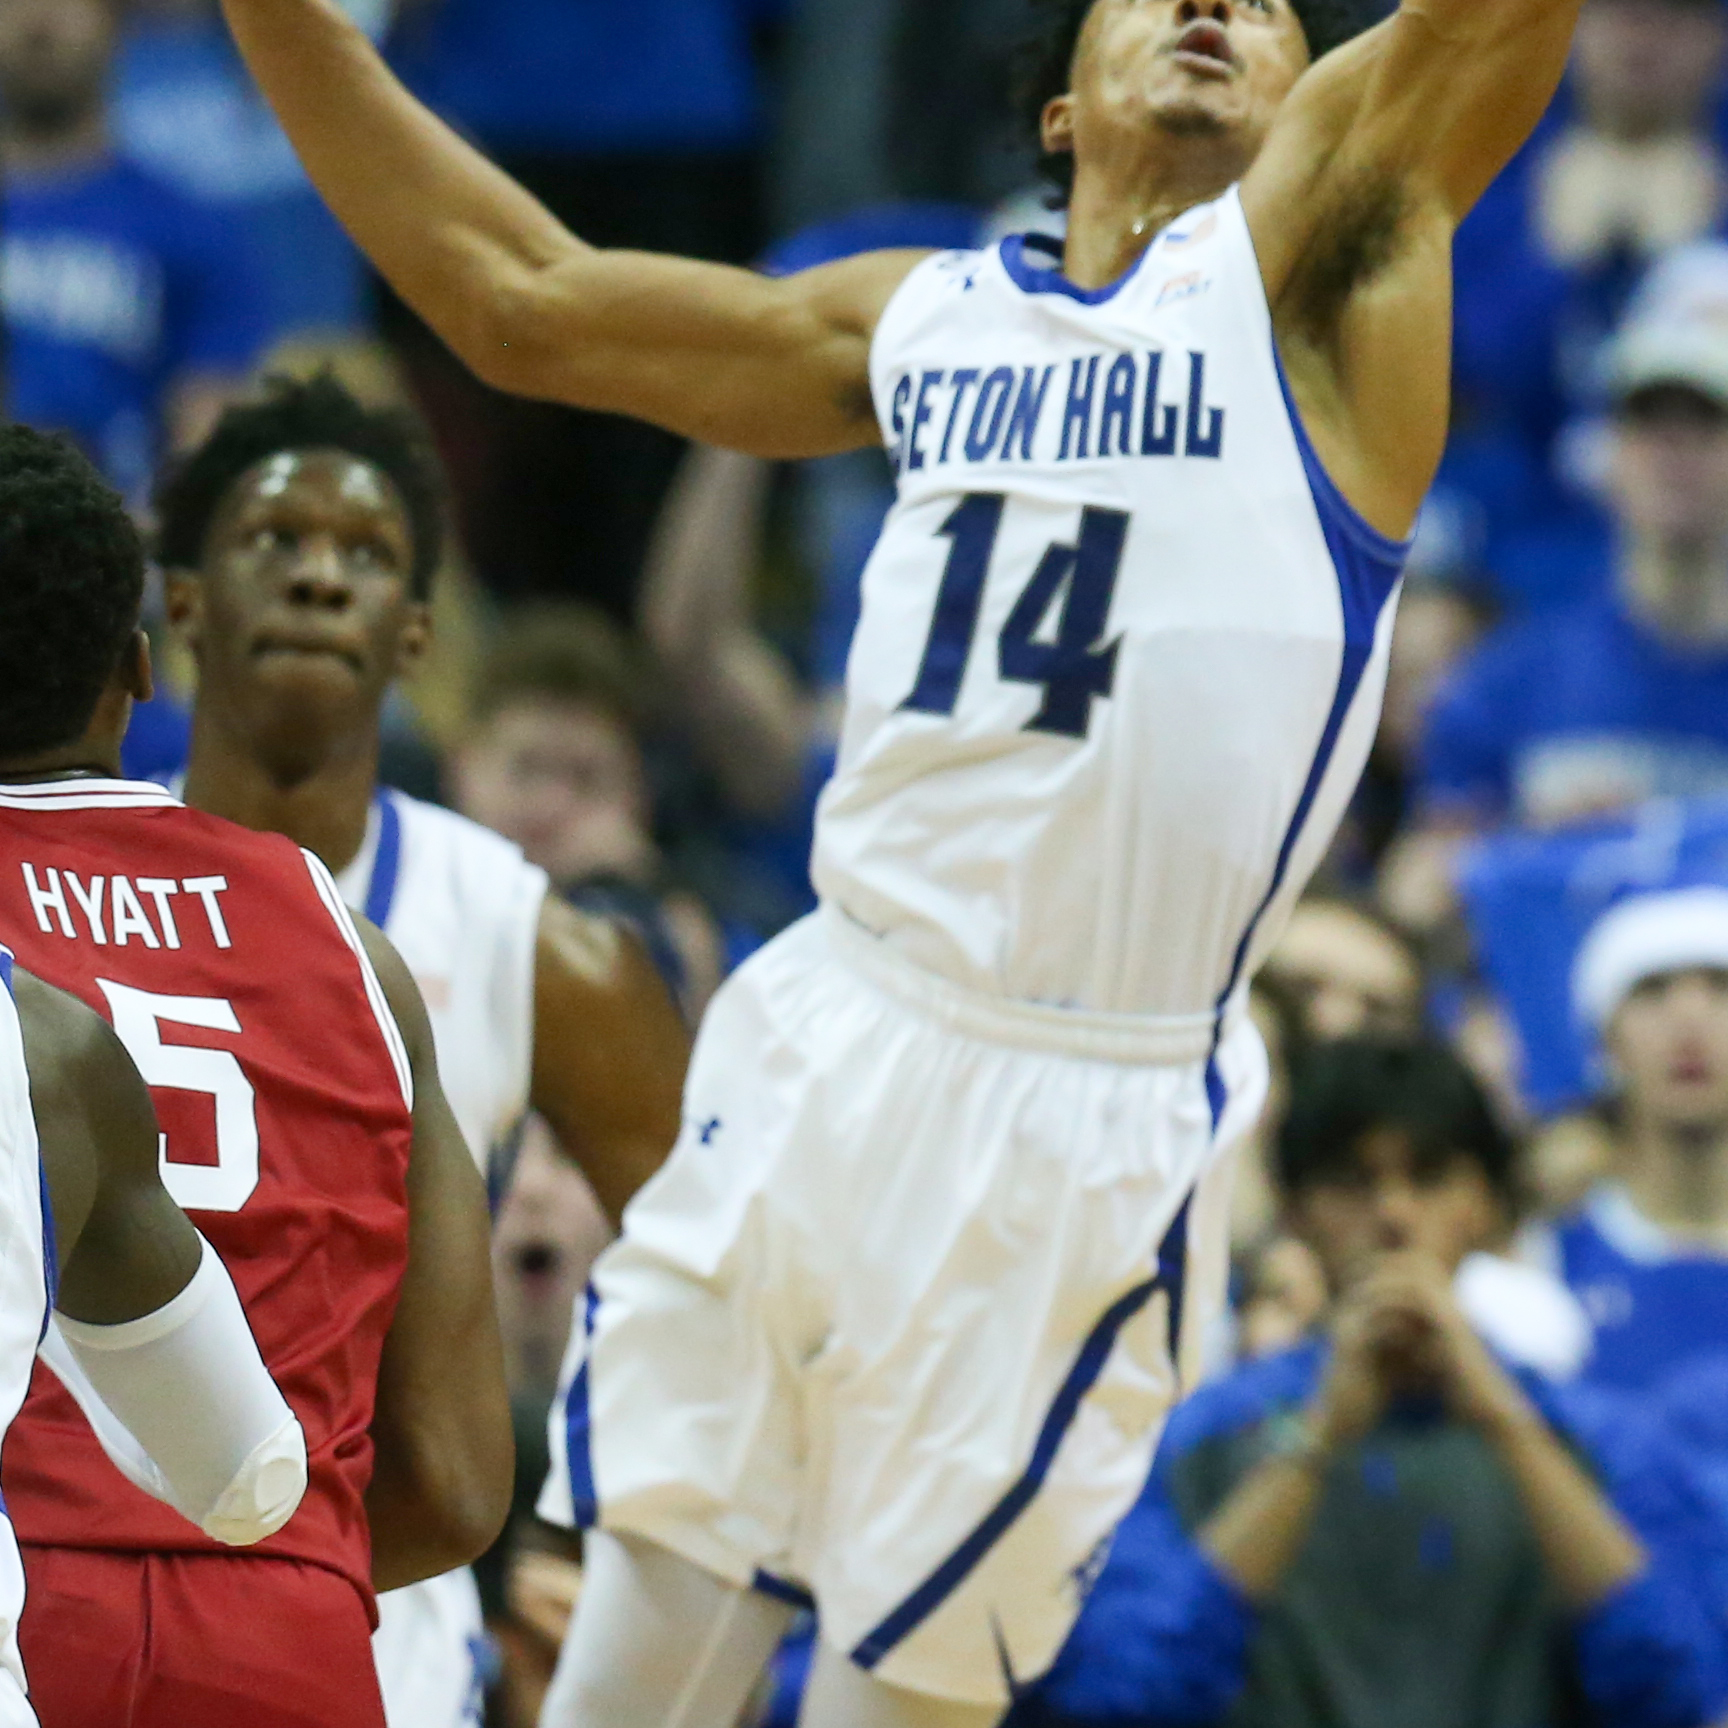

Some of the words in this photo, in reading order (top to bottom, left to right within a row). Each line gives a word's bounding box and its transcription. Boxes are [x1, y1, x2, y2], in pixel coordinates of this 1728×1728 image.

[889, 364, 1057, 471] SETON
[1054, 349, 1226, 460] HALL
[893, 491, 1132, 740] 14
[21, 860, 233, 950] HYATT
[94, 976, 261, 1213] 5
